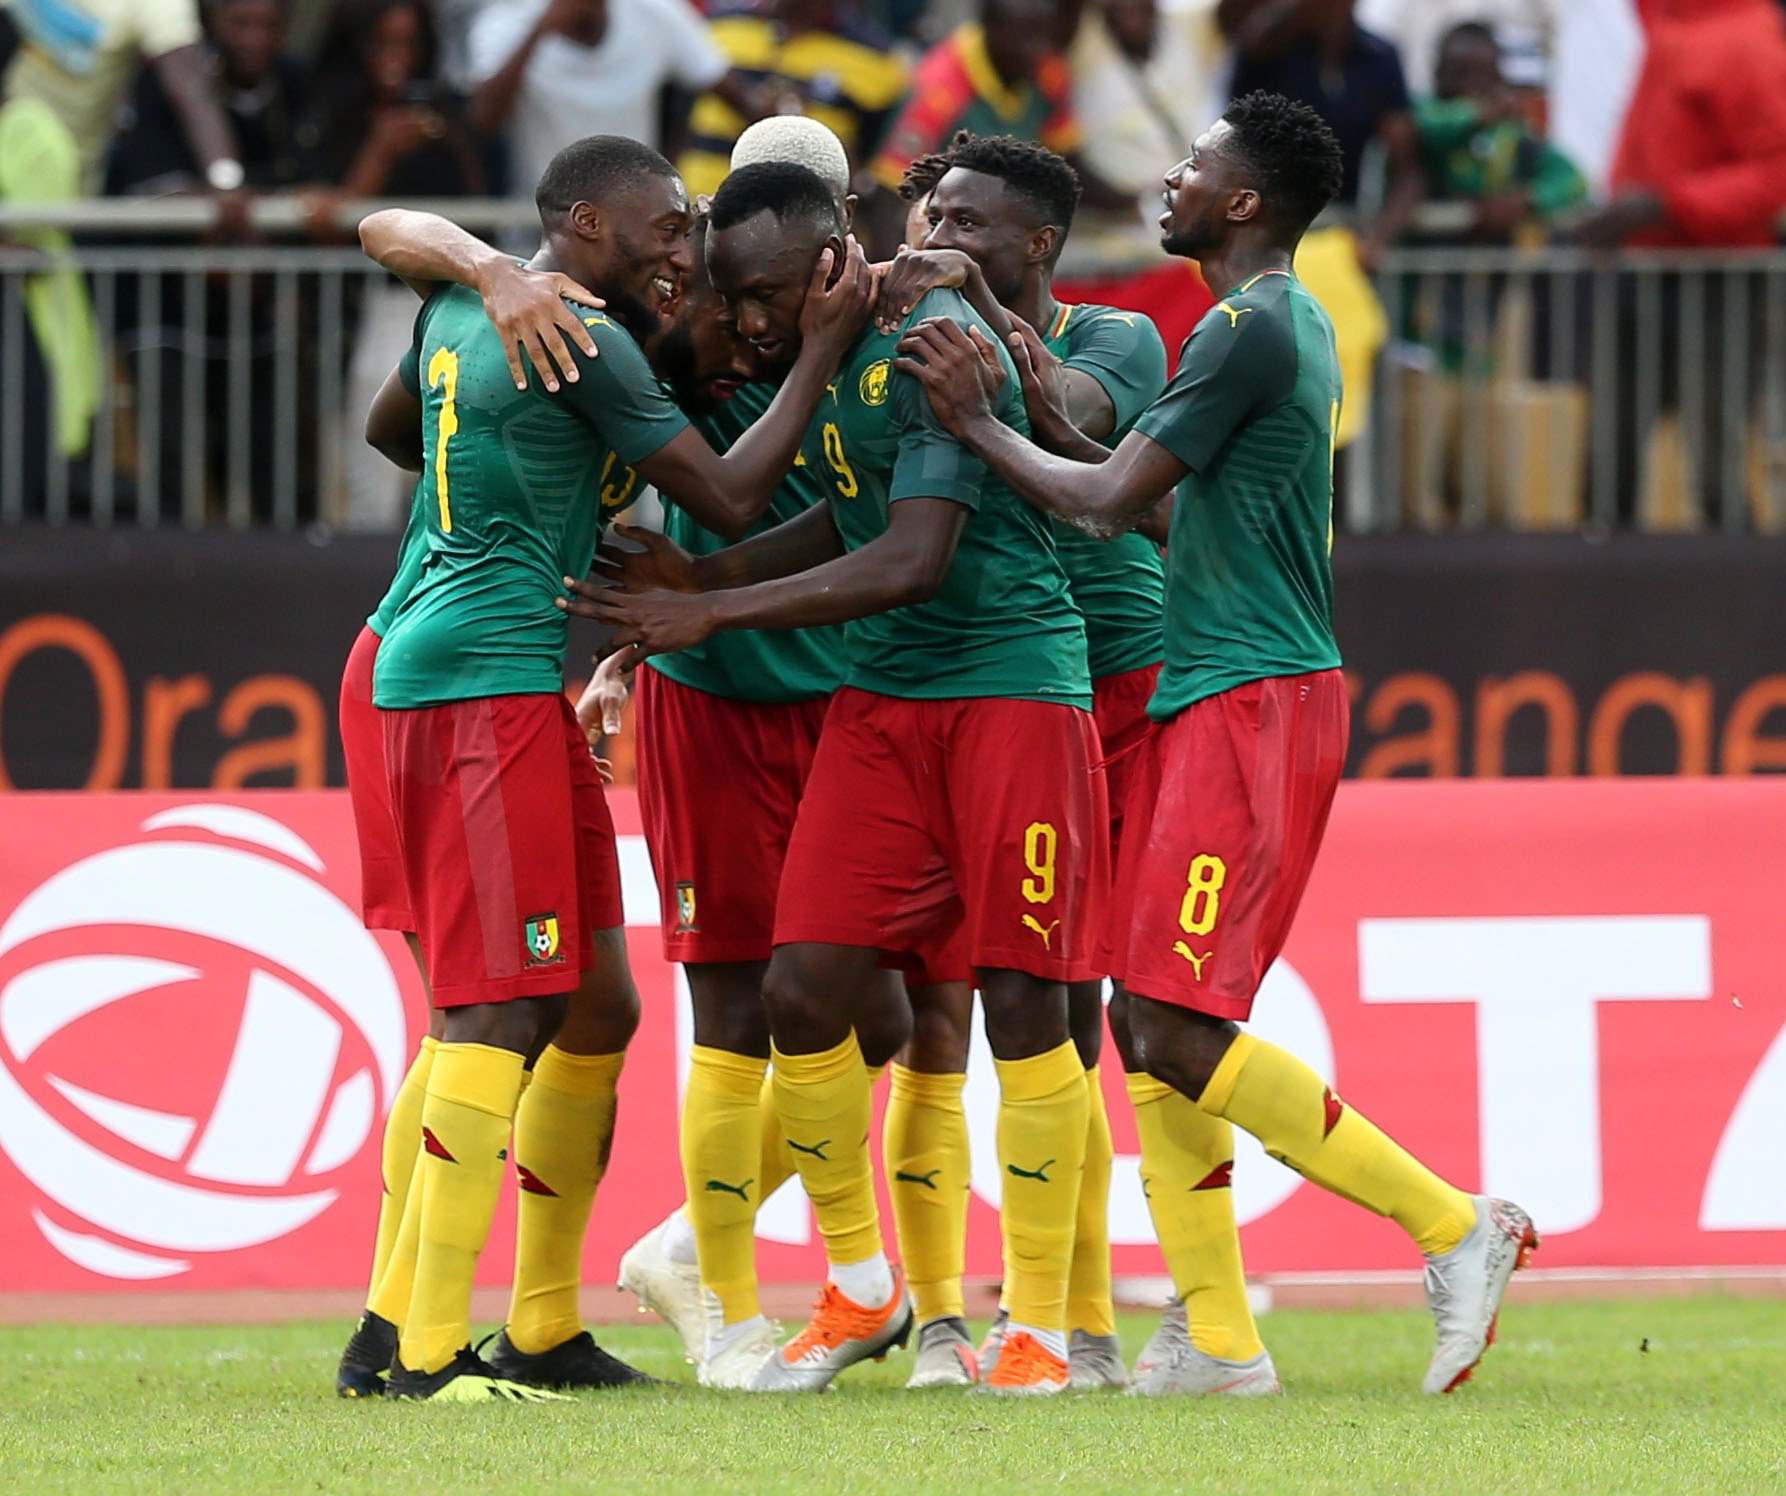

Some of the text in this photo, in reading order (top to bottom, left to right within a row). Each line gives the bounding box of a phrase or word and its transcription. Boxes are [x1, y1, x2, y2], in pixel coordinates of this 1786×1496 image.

[823, 421, 859, 498] 9
[1021, 821, 1057, 904] 9
[1178, 853, 1227, 936] 8
